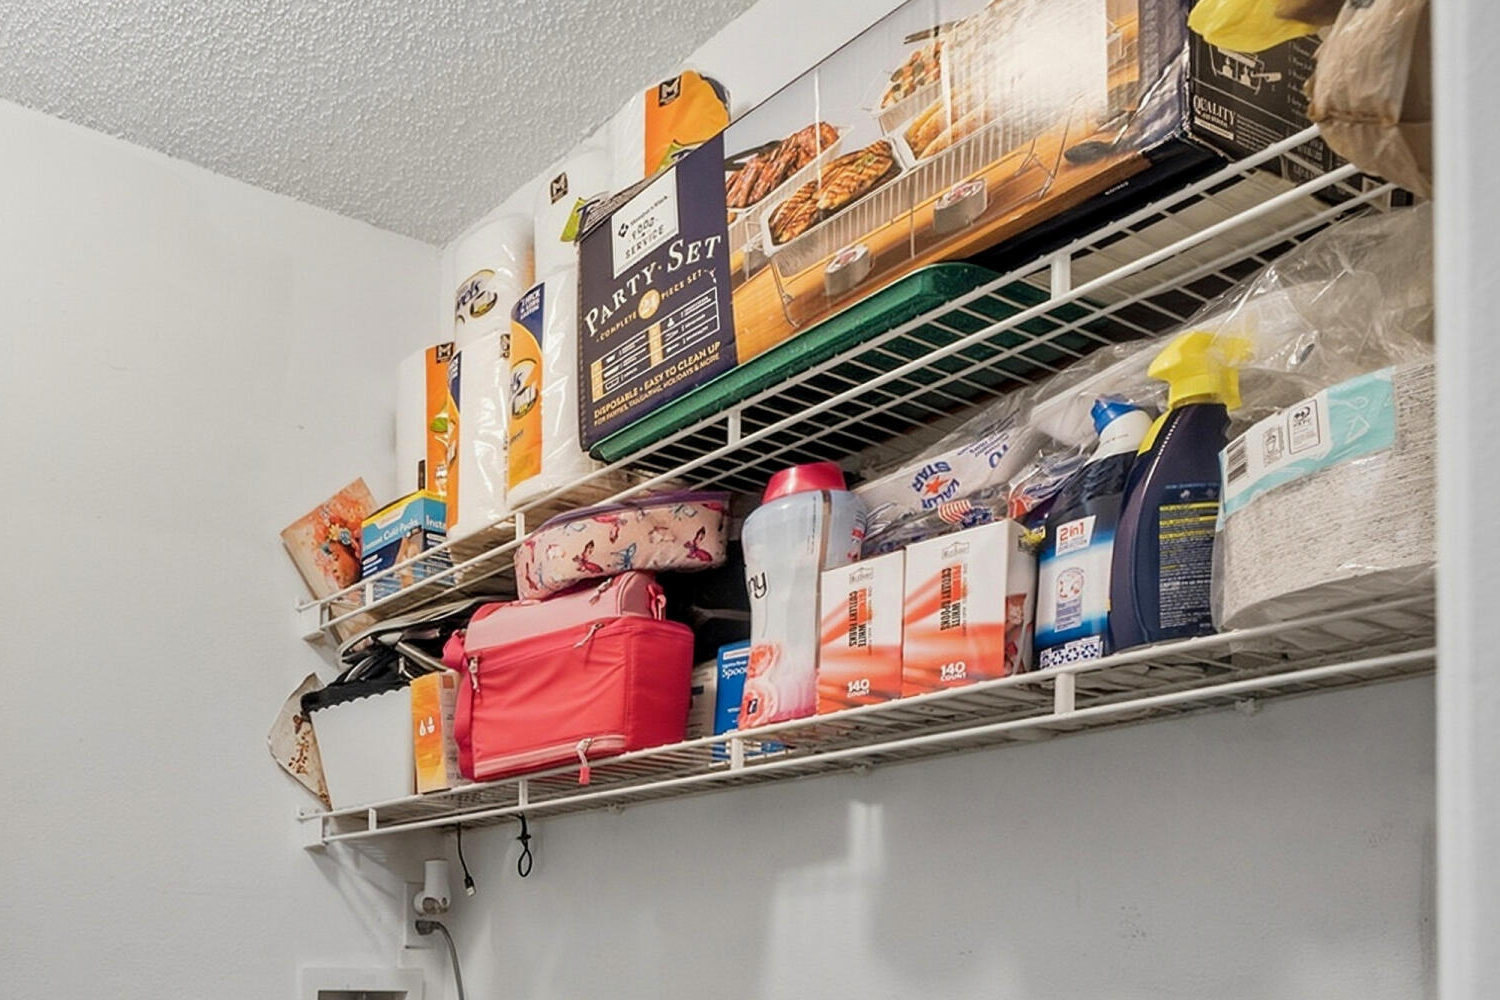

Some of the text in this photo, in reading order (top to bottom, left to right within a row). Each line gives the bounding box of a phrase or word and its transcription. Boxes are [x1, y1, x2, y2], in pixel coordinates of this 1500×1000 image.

[1193, 94, 1236, 126] QUALITY
[625, 224, 665, 260] SERVICE
[584, 261, 657, 337] PARTY
[667, 235, 722, 273] SET
[599, 310, 637, 341] COMPLETE
[661, 281, 685, 300] PIECE
[687, 269, 703, 285] SET
[594, 341, 721, 419] DISPOSABLE EASY TO CLEAN UP
[912, 460, 952, 493] STAR
[848, 590, 858, 648] CUTLERY FORKS
[951, 602, 961, 628] WHITE
[858, 622, 867, 648] WHITE
[940, 660, 966, 676] 140
[940, 670, 967, 683] COUNT
[846, 688, 870, 699] COUNT
[847, 678, 870, 693] 140
